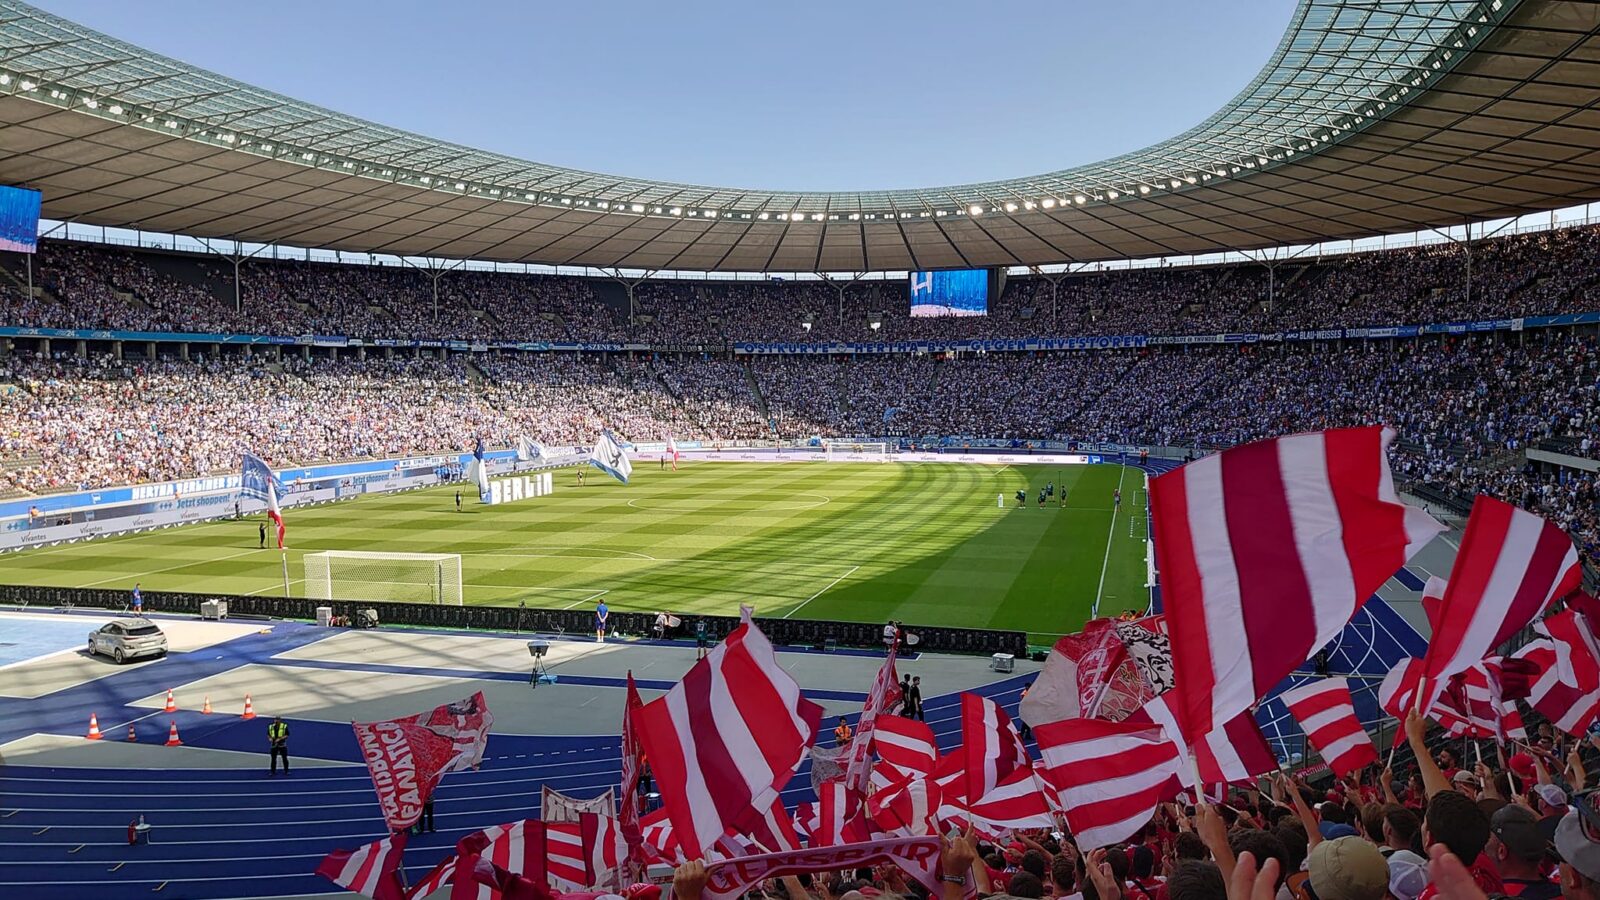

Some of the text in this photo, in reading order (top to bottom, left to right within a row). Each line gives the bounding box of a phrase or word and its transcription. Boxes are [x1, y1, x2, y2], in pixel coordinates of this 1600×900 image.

[1300, 330, 1341, 339] BLAU-WEISSES
[1345, 328, 1369, 338] STADION
[744, 343, 829, 353] OSTKURVE
[855, 341, 919, 353] HERTHA
[927, 340, 958, 351] BSC
[971, 340, 1027, 351] GEGEN
[1037, 335, 1145, 350] INVESTOREN
[132, 483, 174, 500] HERTHA
[177, 479, 225, 495] BERLINER
[490, 472, 552, 504] BERLIN
[177, 499, 196, 509] Jetzt
[196, 493, 231, 507] shoppen!
[80, 524, 103, 534] Vivantes
[133, 517, 153, 526] Vivantes
[21, 532, 47, 542] Vivantes
[376, 722, 422, 818] FANATICA
[704, 842, 944, 894] GENSBUR
